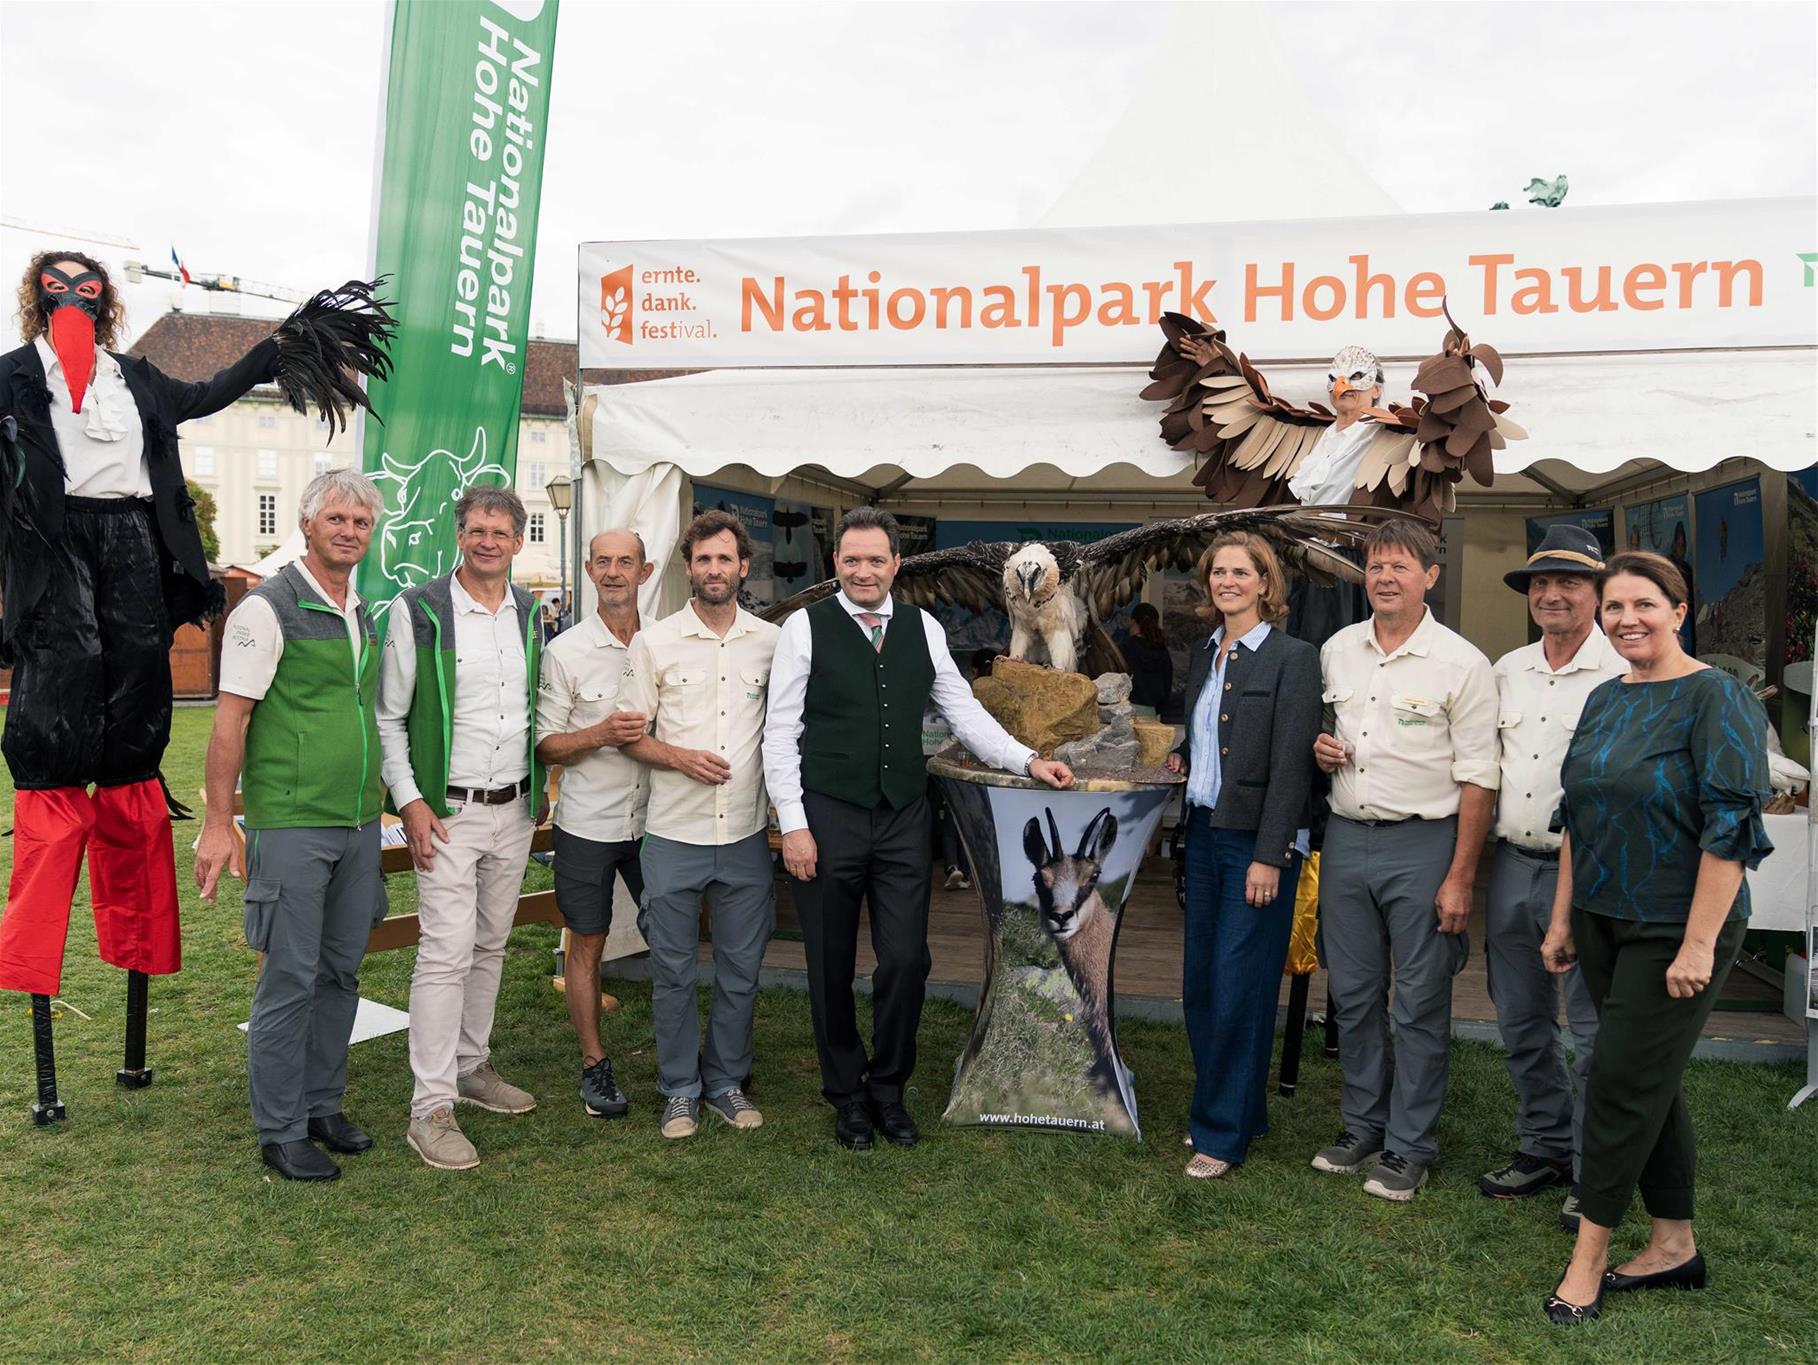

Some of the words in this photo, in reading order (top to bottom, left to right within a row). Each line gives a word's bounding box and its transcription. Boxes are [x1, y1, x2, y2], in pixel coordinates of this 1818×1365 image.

[470, 15, 509, 161] Hohe
[451, 180, 497, 358] Tauern
[641, 267, 701, 285] ernte.
[641, 292, 697, 313] dank.
[741, 260, 1218, 348] Nationalpark
[1244, 254, 1447, 323] Hohe
[1469, 253, 1764, 316] Tauern
[640, 320, 718, 340] festival.
[979, 1112, 1105, 1131] www.hohetauern.at
